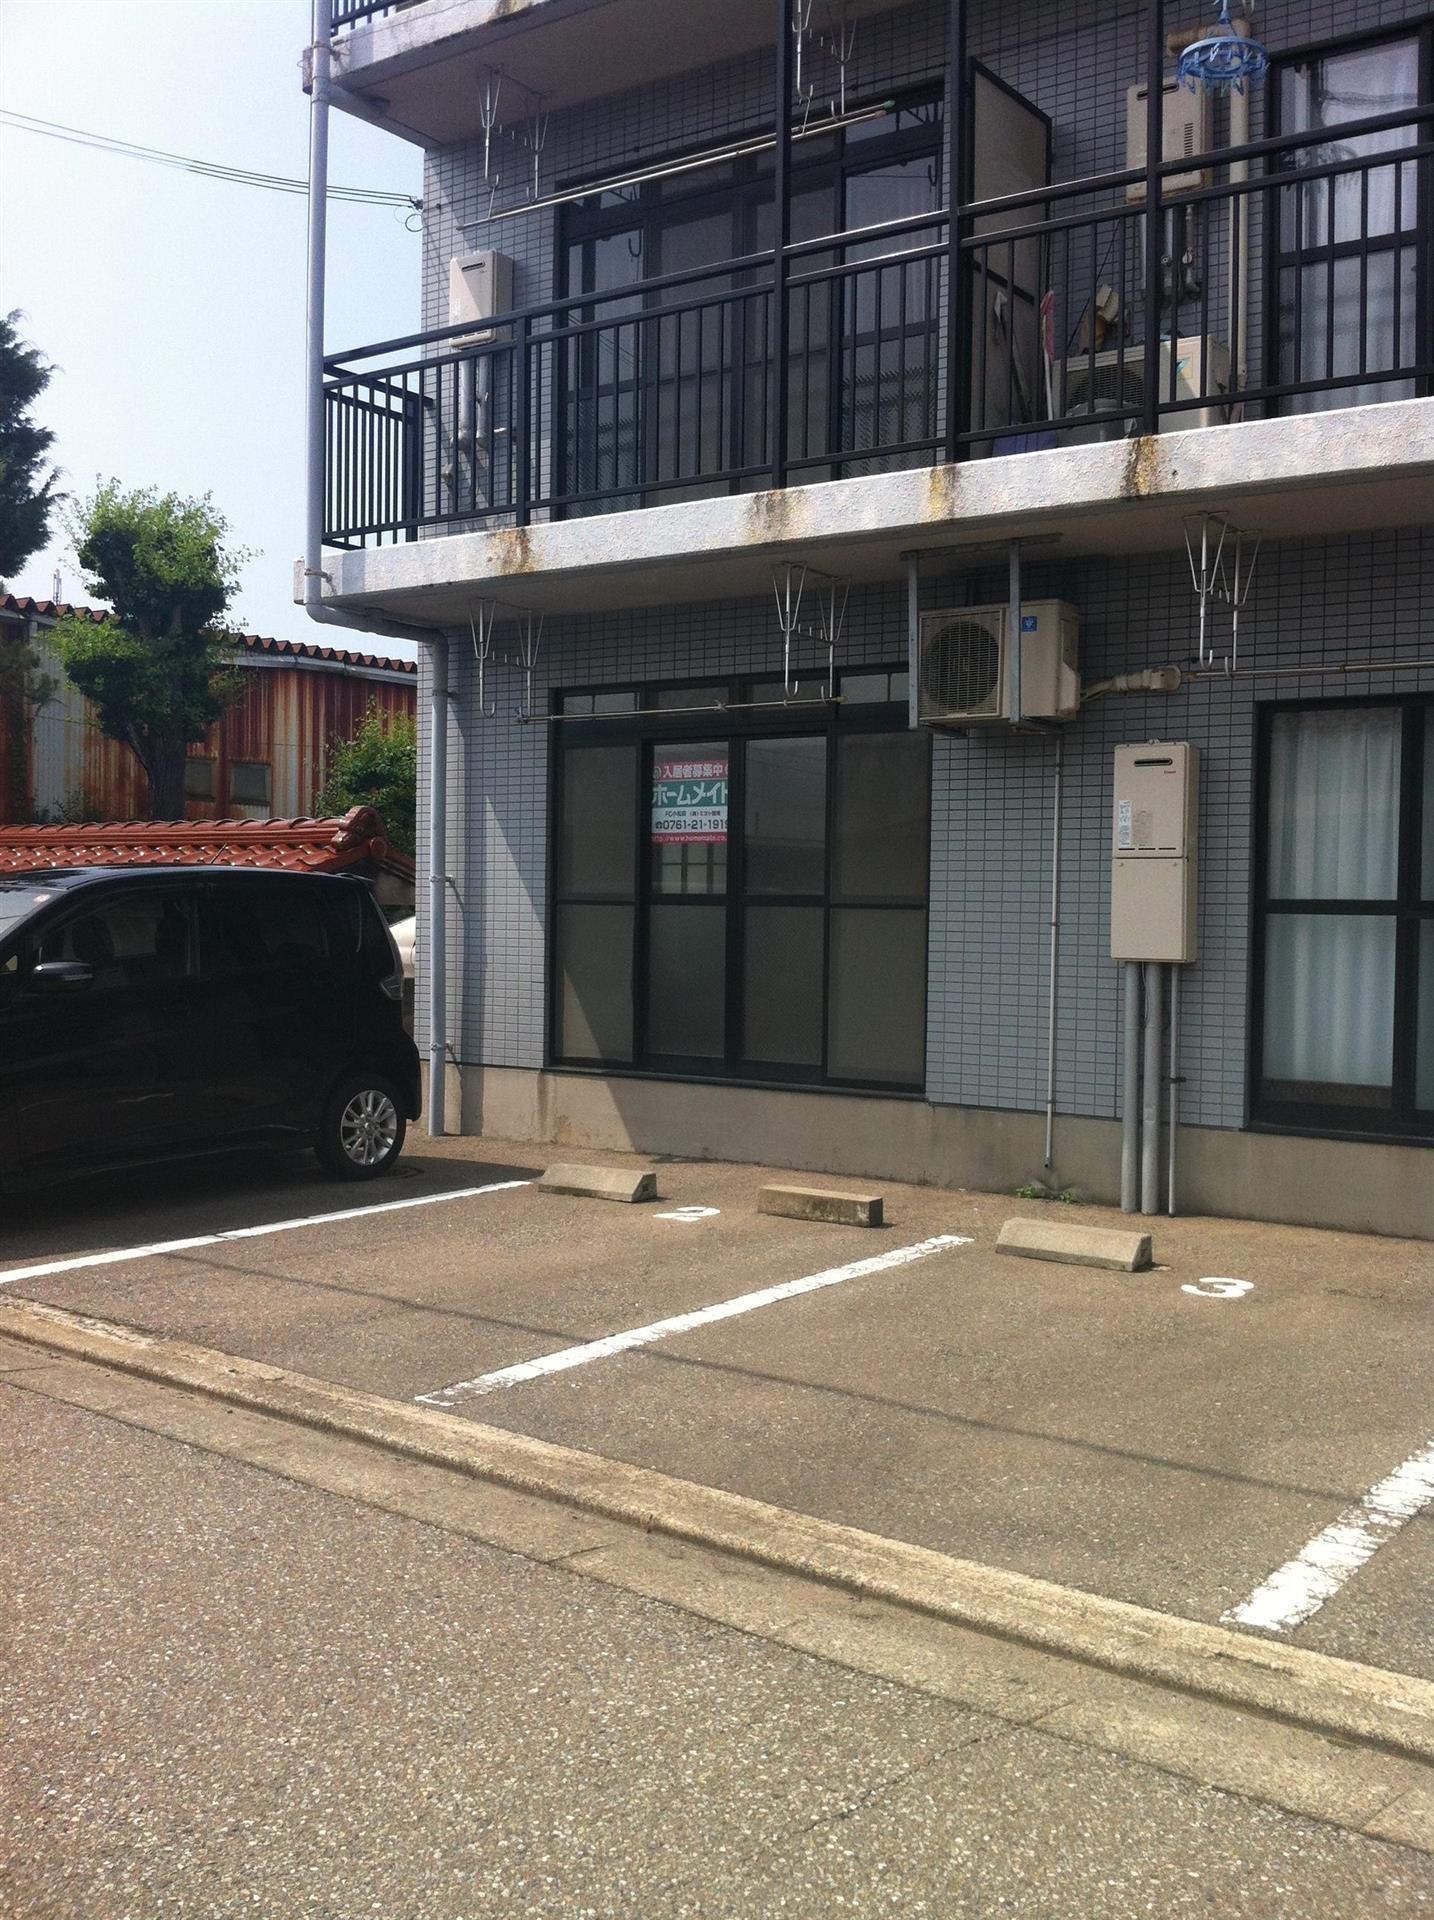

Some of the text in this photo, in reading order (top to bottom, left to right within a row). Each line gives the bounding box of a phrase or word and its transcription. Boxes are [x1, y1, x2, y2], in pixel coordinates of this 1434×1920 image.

[652, 781, 728, 806] ホームメイト
[653, 1206, 720, 1222] 2
[1180, 1276, 1255, 1298] 3
